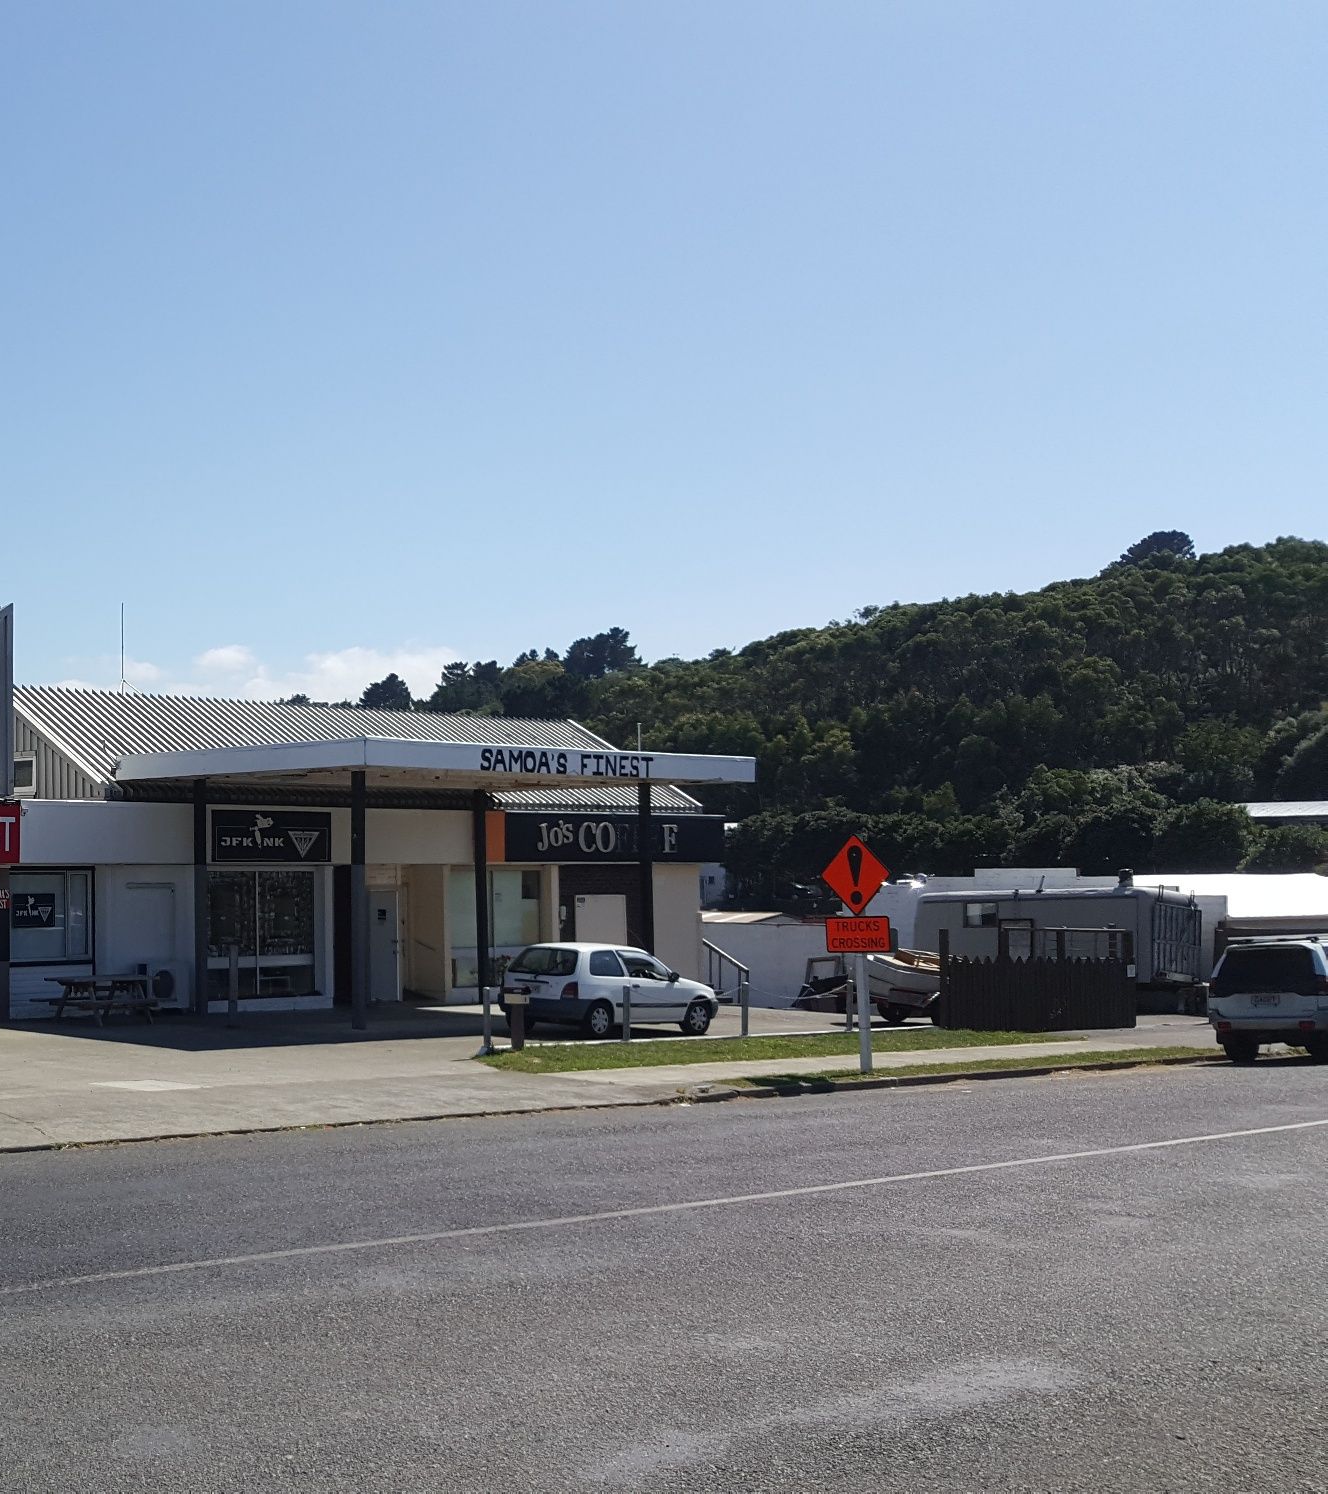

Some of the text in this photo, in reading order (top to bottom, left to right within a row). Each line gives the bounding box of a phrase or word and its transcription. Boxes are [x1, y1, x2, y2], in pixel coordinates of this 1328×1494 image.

[480, 748, 654, 778] SAMOA'S FINEST
[221, 836, 253, 847] JFK
[835, 920, 880, 932] TRUCKS
[832, 937, 886, 949] CROSSING
